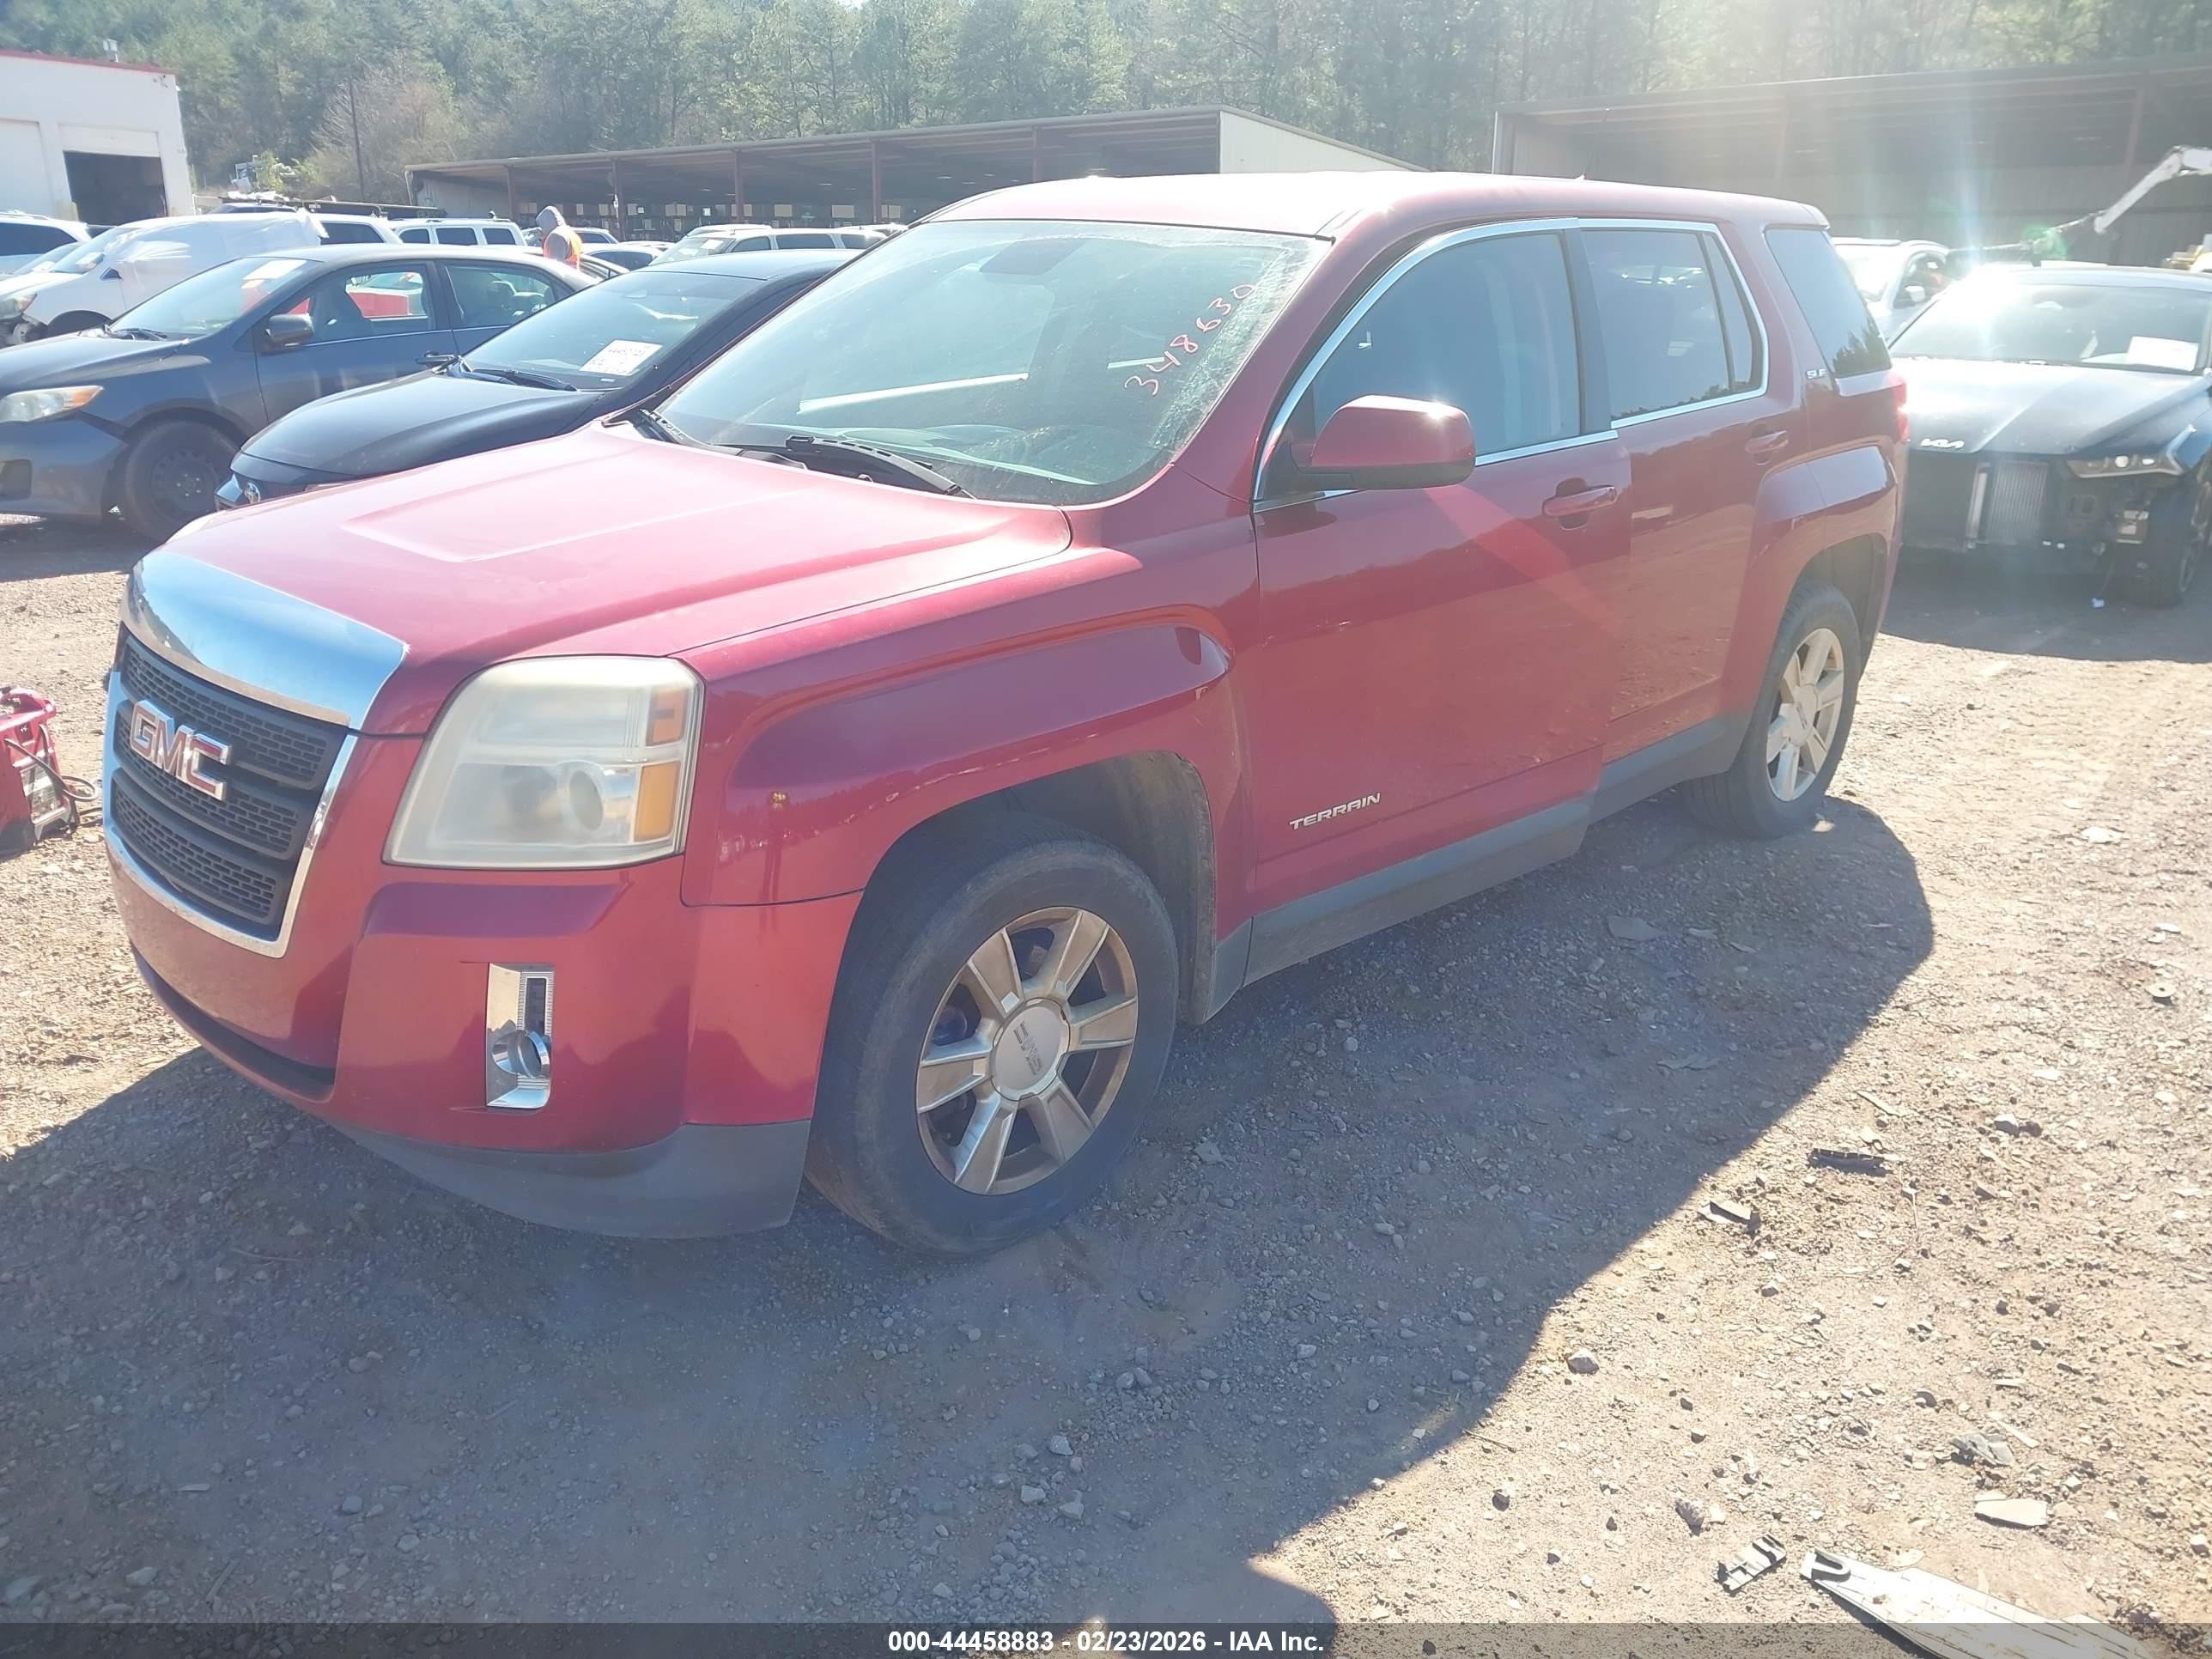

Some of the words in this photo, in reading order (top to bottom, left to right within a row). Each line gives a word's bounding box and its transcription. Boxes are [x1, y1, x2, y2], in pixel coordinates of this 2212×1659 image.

[1124, 284, 1256, 396] 348630
[130, 700, 232, 800] GMC
[1289, 793, 1381, 830] TERRAIN
